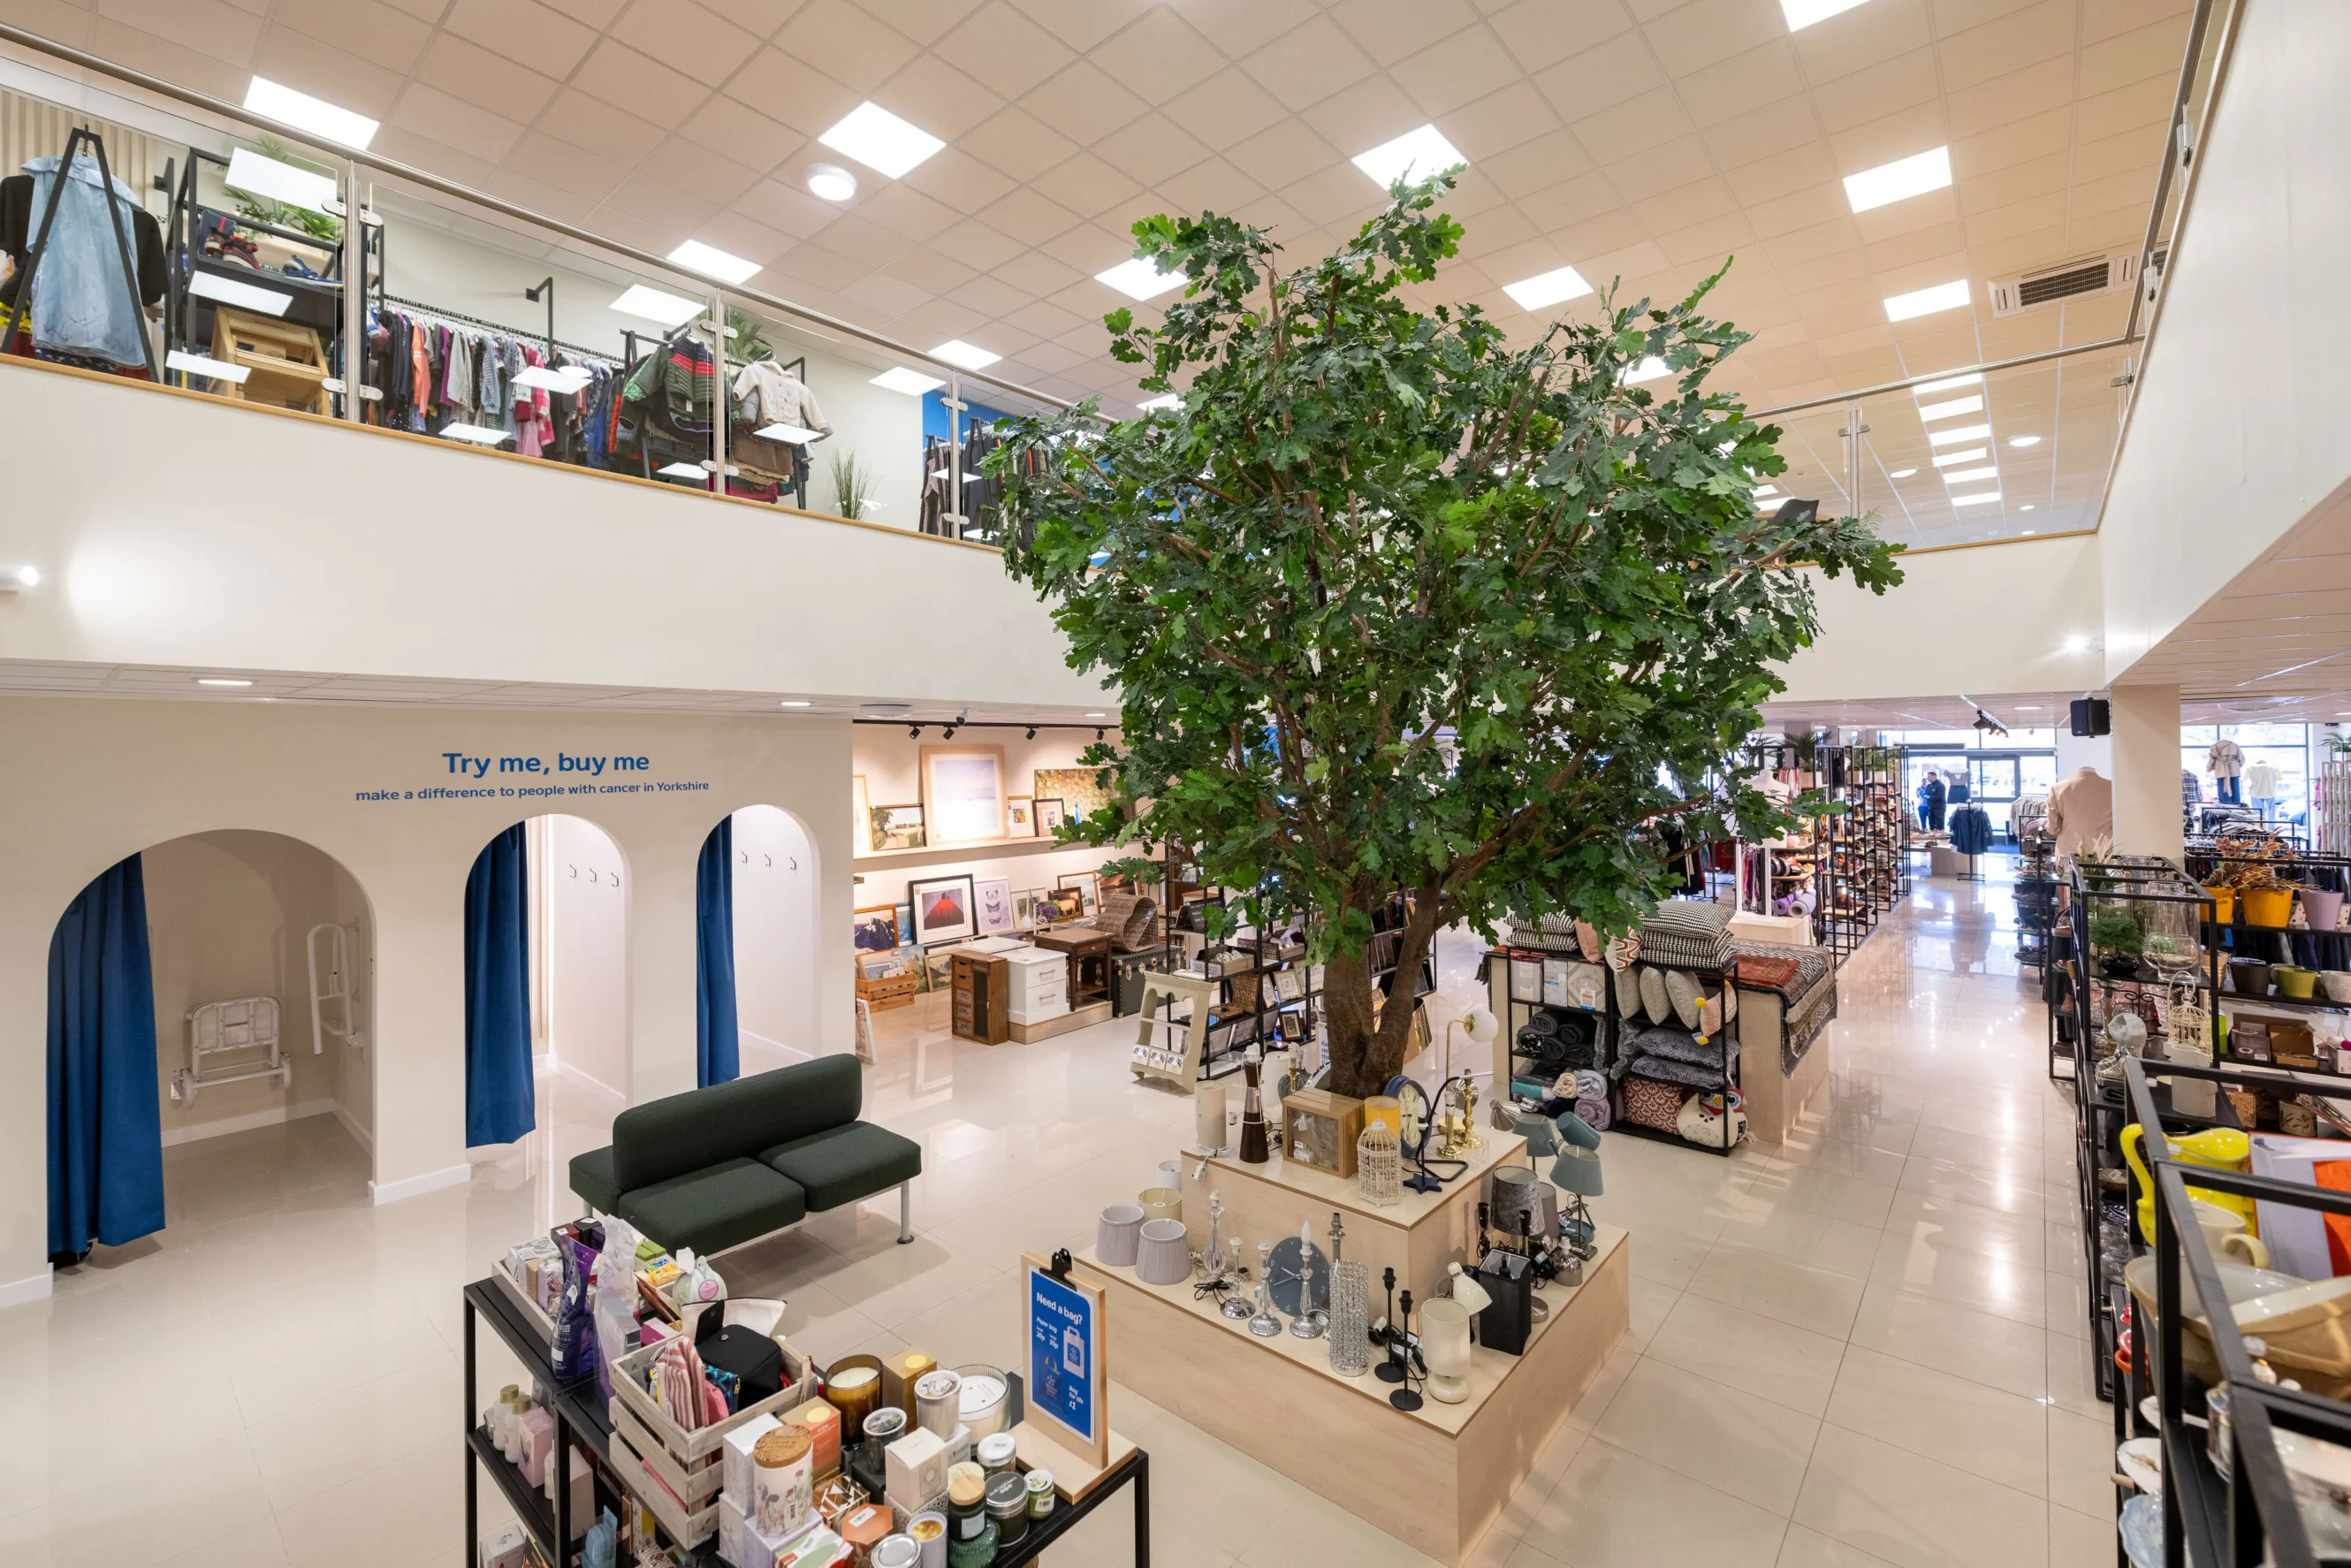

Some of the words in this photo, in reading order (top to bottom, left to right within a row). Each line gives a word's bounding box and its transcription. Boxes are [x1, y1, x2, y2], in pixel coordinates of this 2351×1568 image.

[442, 753, 491, 779] Try
[499, 757, 550, 775] me,
[559, 752, 606, 776] buy
[613, 756, 650, 771] me
[355, 789, 399, 801] make
[404, 790, 414, 800] a
[417, 788, 495, 799] difference
[498, 787, 514, 796] to
[519, 785, 565, 798] people
[568, 784, 597, 795] with
[599, 783, 641, 794] cancer
[643, 782, 654, 792] in
[657, 781, 710, 792] Yorkshire
[1235, 978, 1258, 988] SUCCESS
[1234, 988, 1257, 1002] WORK
[1036, 1291, 1057, 1311] Need
[1057, 1305, 1063, 1314] a
[1063, 1305, 1083, 1325] bag?
[1036, 1316, 1048, 1328] Paper
[1048, 1323, 1058, 1334] bag
[1036, 1330, 1046, 1342] 20p
[1049, 1338, 1059, 1350] 50p
[1069, 1385, 1078, 1396] Bag
[1069, 1400, 1077, 1411] £1
